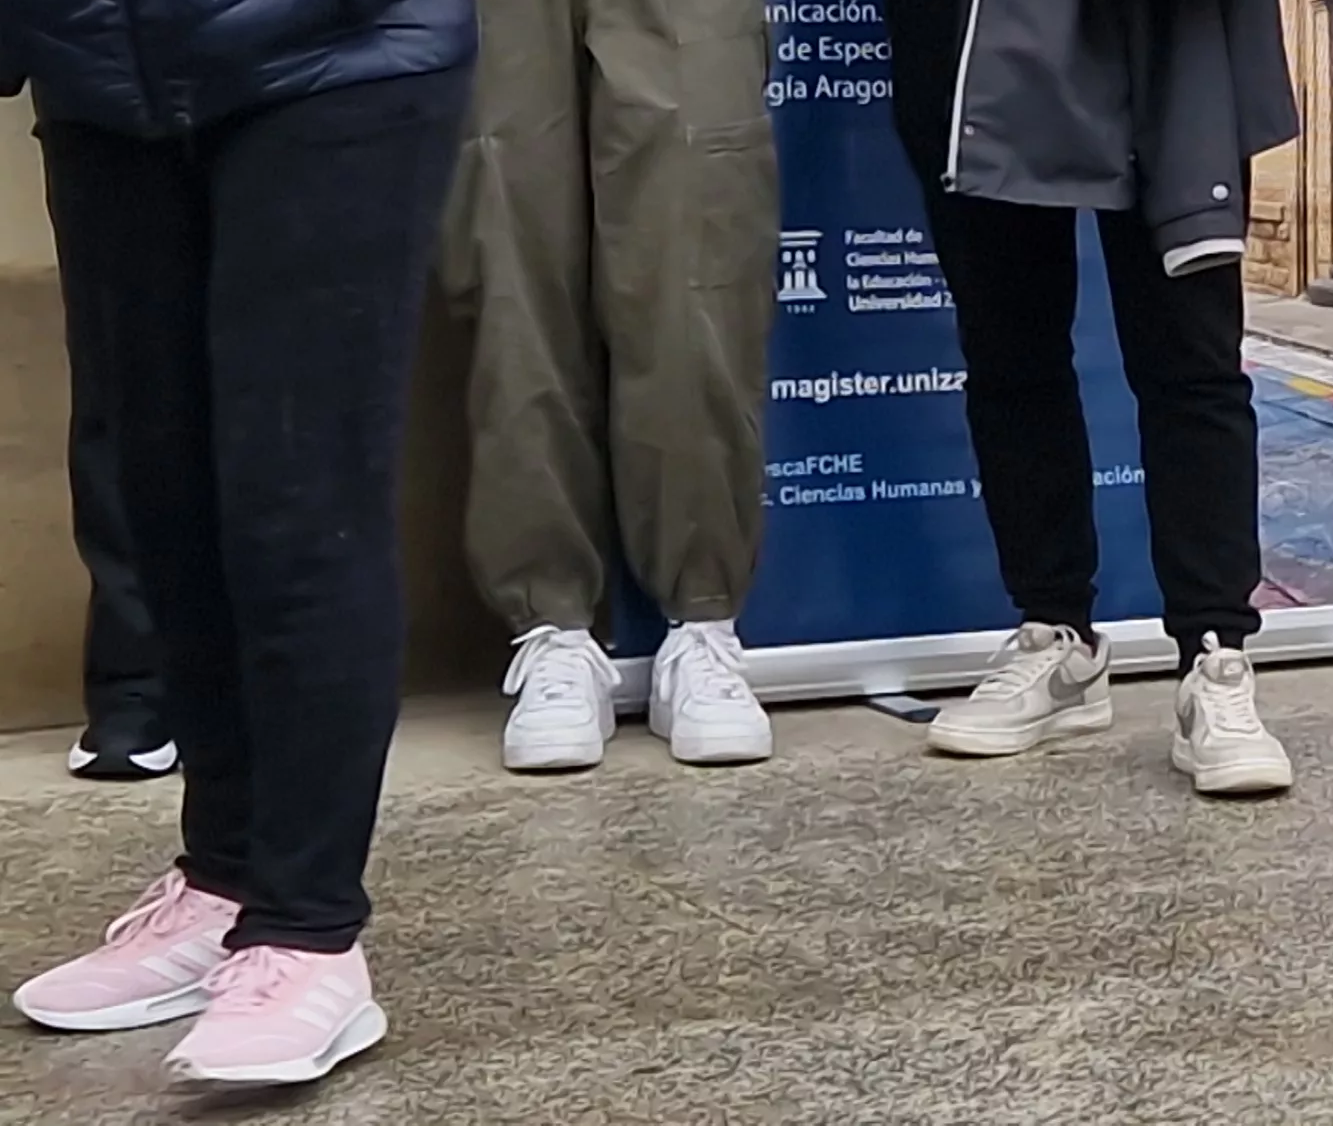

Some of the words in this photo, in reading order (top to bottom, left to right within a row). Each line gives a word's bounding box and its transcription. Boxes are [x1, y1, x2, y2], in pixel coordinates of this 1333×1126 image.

[777, 35, 813, 62] de
[779, 482, 866, 506] Ciencias
[871, 477, 967, 501] Humanas
